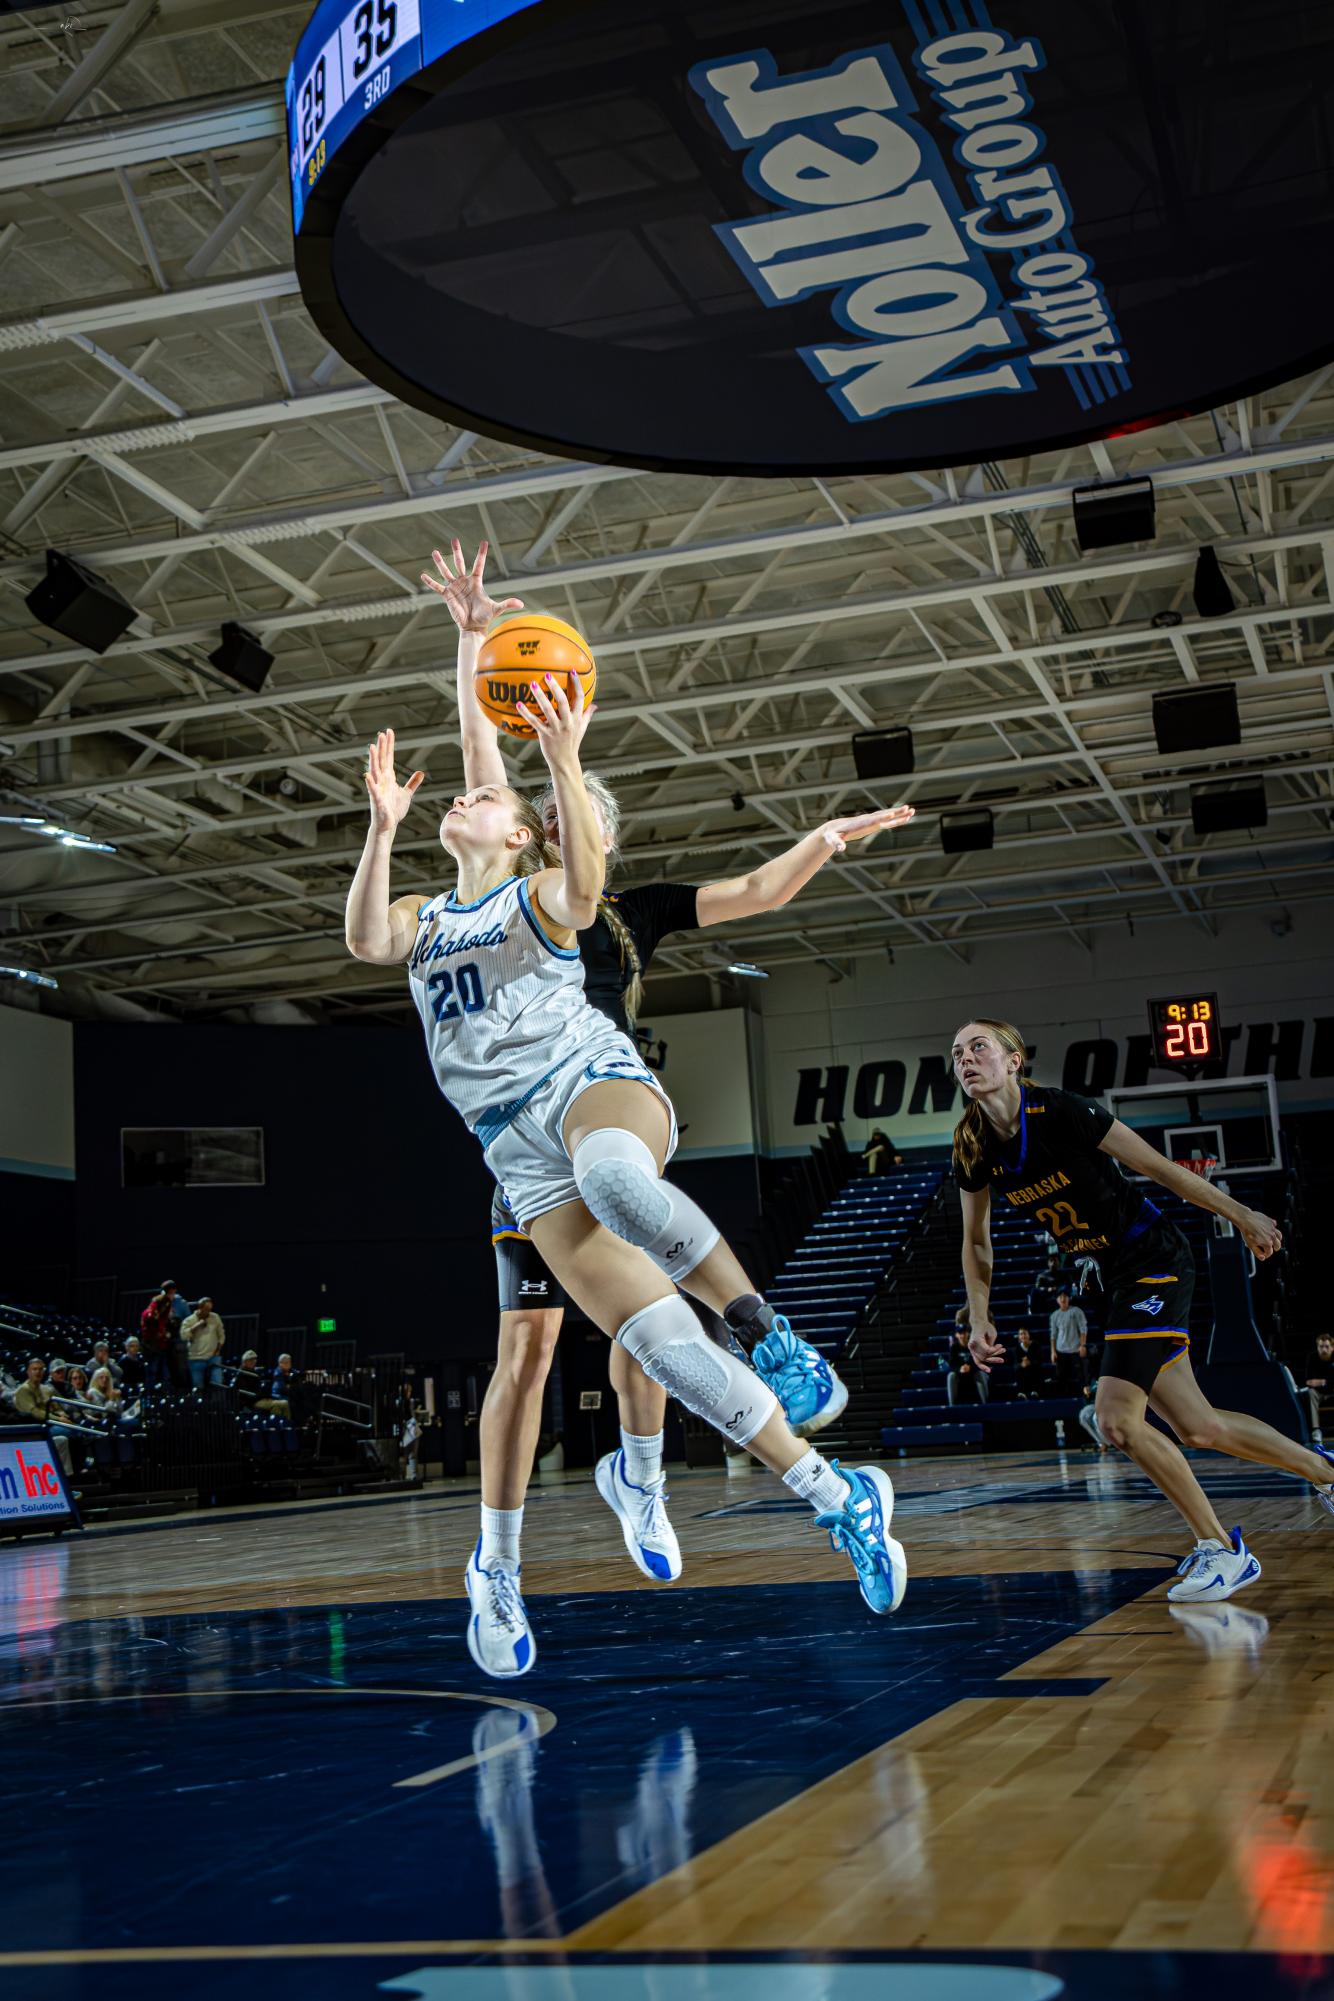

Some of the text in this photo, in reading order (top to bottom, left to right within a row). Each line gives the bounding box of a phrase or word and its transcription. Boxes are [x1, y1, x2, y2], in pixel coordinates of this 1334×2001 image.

[353, 0, 397, 79] 35
[303, 55, 326, 153] 29
[364, 65, 391, 110] 3RD
[704, 55, 1023, 417] Noller
[428, 963, 486, 1023] 20
[1168, 1001, 1210, 1021] 9:13
[1166, 1022, 1209, 1057] 20
[1005, 1170, 1071, 1206] NEBRASKA
[1035, 1201, 1089, 1237] 22
[15, 1449, 59, 1498] Inc
[21, 1502, 65, 1513] Solutions
